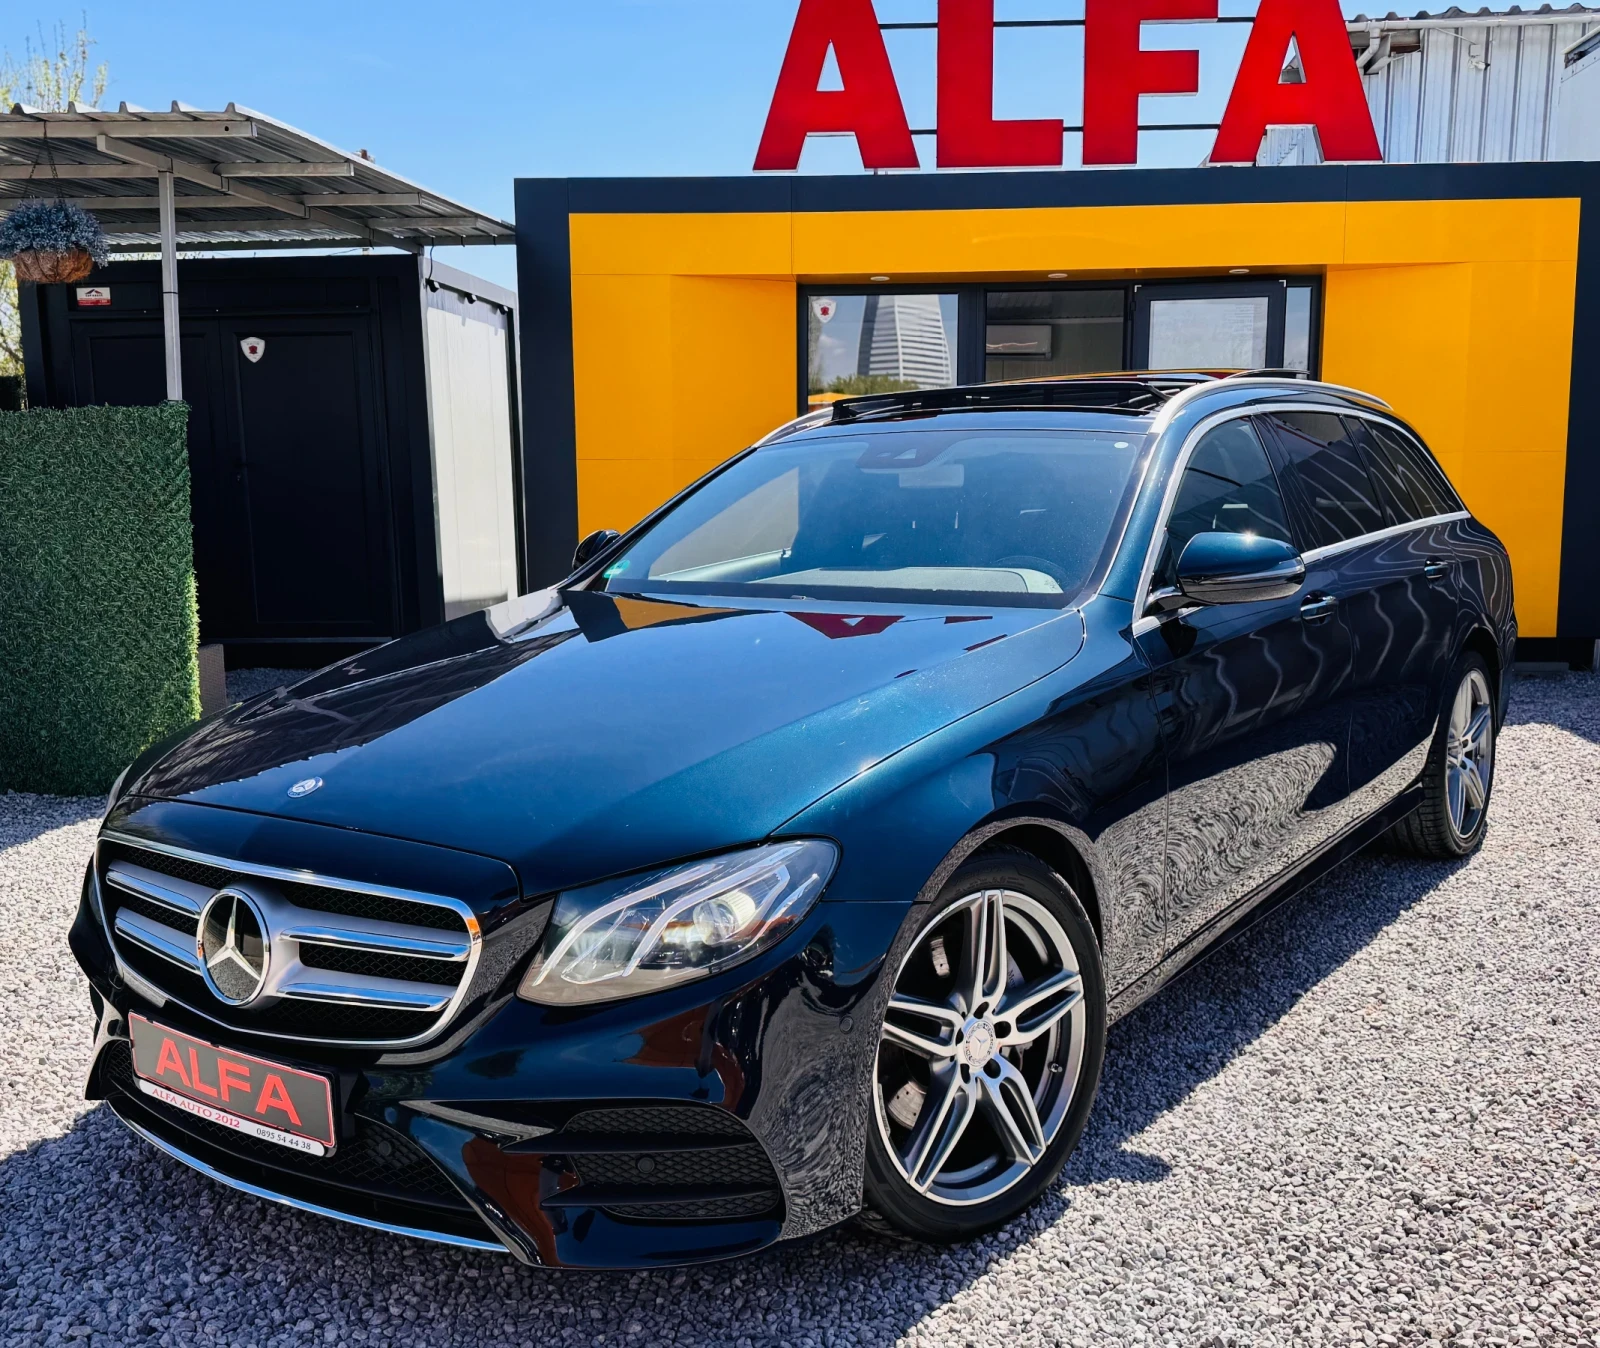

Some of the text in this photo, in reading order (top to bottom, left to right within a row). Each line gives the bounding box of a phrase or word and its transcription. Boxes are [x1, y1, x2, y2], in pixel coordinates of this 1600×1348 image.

[753, 0, 1384, 171] ALFA
[152, 1088, 240, 1128] ALFA AUTO 2012
[156, 1037, 302, 1126] ALFA
[256, 1127, 311, 1151] 0895 54 44 38
